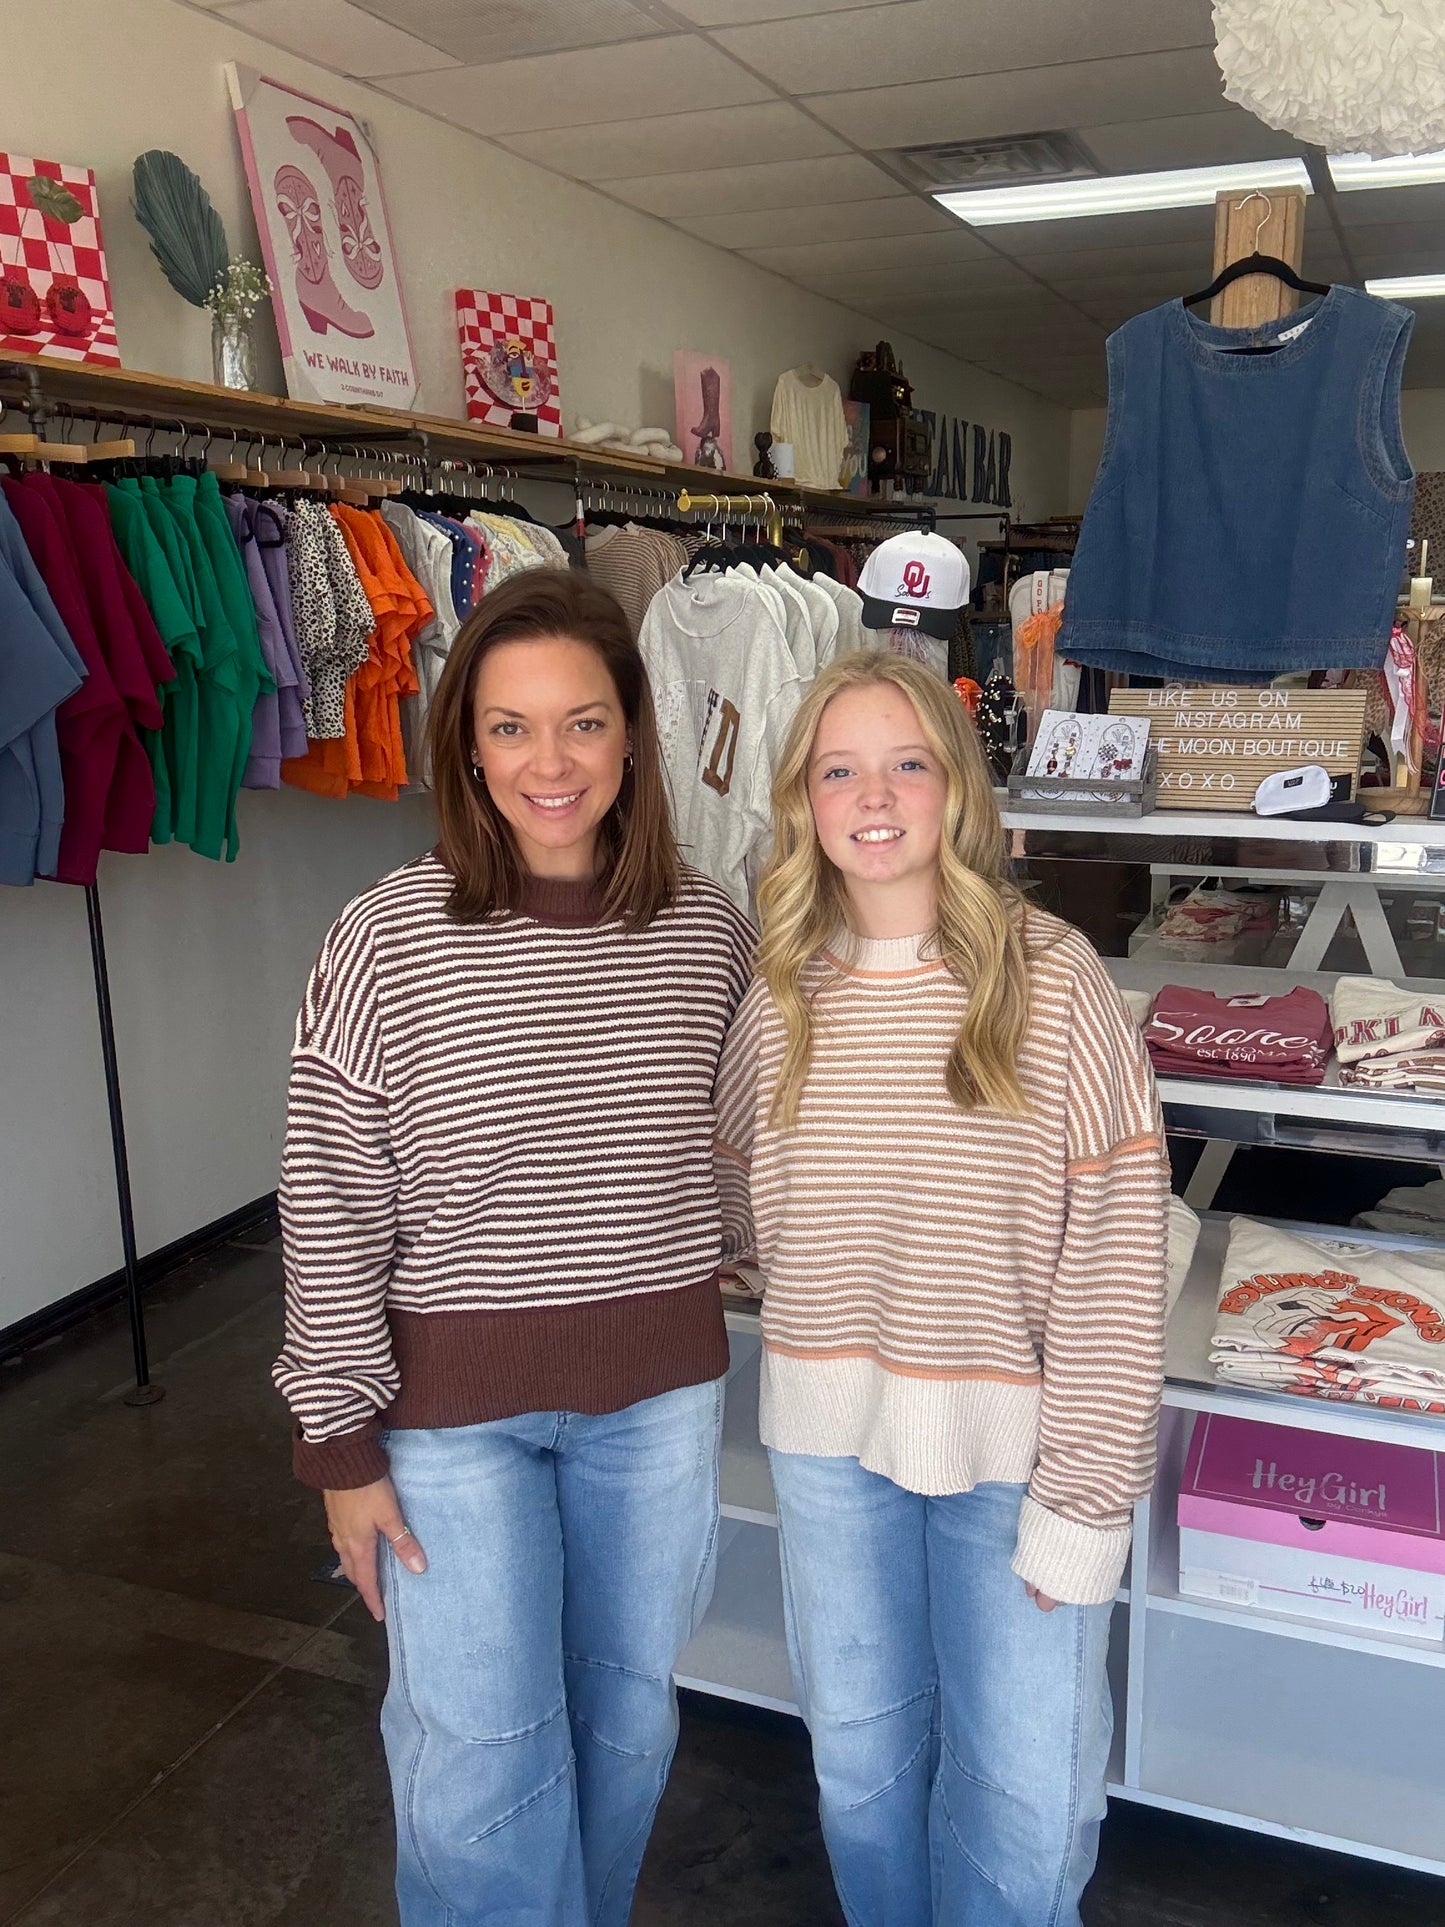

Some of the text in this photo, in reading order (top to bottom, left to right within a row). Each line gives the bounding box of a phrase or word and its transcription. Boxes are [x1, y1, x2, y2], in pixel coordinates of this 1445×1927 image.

[303, 350, 409, 386] WE WALK BY FAITH
[971, 424, 1012, 508] BAR
[903, 560, 930, 598] OU
[1148, 690, 1289, 708] LIKE US ON
[1174, 711, 1303, 730] INSTAGRAM
[1148, 737, 1350, 758] HE MOON BOUTIQUE
[1196, 1048, 1219, 1060] est.
[1224, 1049, 1256, 1063] 1890
[1218, 1273, 1350, 1316] ROLLING
